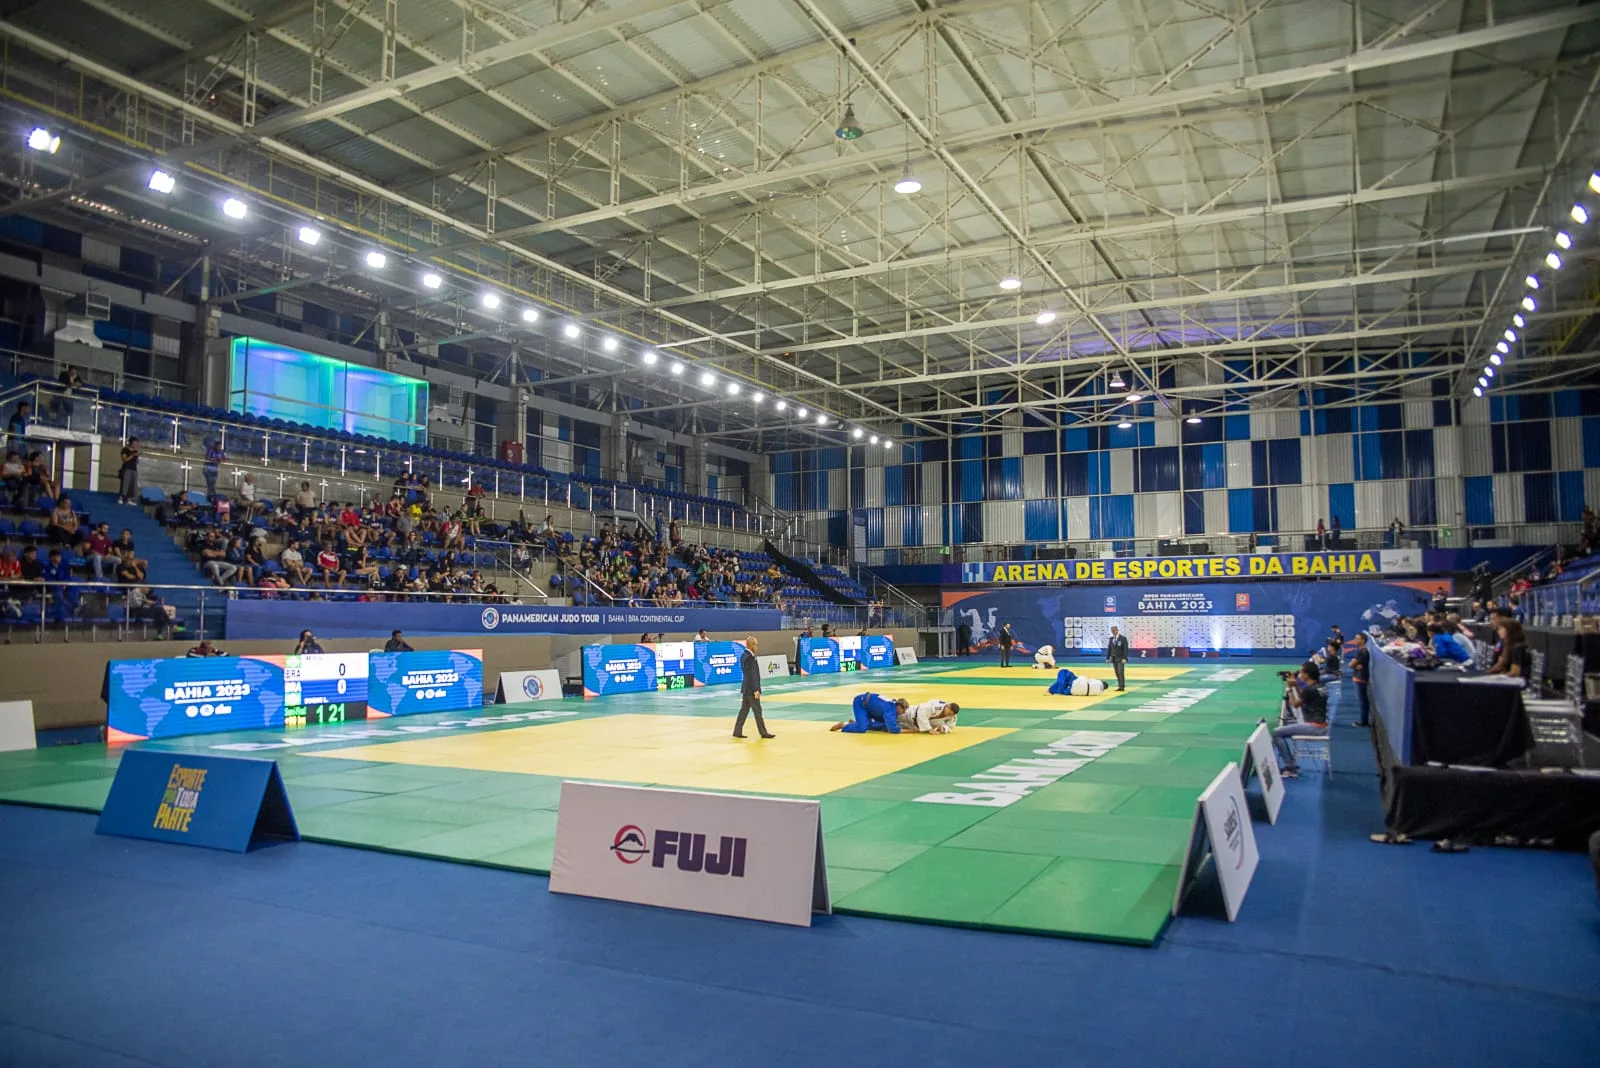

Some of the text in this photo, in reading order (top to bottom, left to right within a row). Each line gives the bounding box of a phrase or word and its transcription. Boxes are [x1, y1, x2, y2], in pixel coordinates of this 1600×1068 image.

[993, 561, 1069, 582] ARENA
[1075, 561, 1105, 580] DE
[1113, 558, 1239, 580] ESPORTES
[1250, 556, 1283, 575] DA
[1292, 554, 1376, 575] BAHIA
[1138, 600, 1213, 610] BAHIA 2023
[502, 613, 559, 623] PANAMERICAN
[560, 613, 580, 623] JUDO
[581, 614, 600, 623] TOUR
[608, 614, 625, 623] BAHIA
[640, 615, 673, 623] CONTINENTAL
[674, 615, 685, 623] CUP
[1171, 648, 1176, 657] 1
[285, 669, 301, 679] BRA
[339, 663, 345, 676] 0
[402, 673, 434, 685] BAHIA
[435, 672, 459, 683] 2023
[165, 684, 250, 700] BAHIA 2023
[337, 679, 346, 693] 0
[911, 757, 1097, 808] BAHIA
[153, 803, 195, 832] PARTE
[652, 829, 748, 878] FUJI
